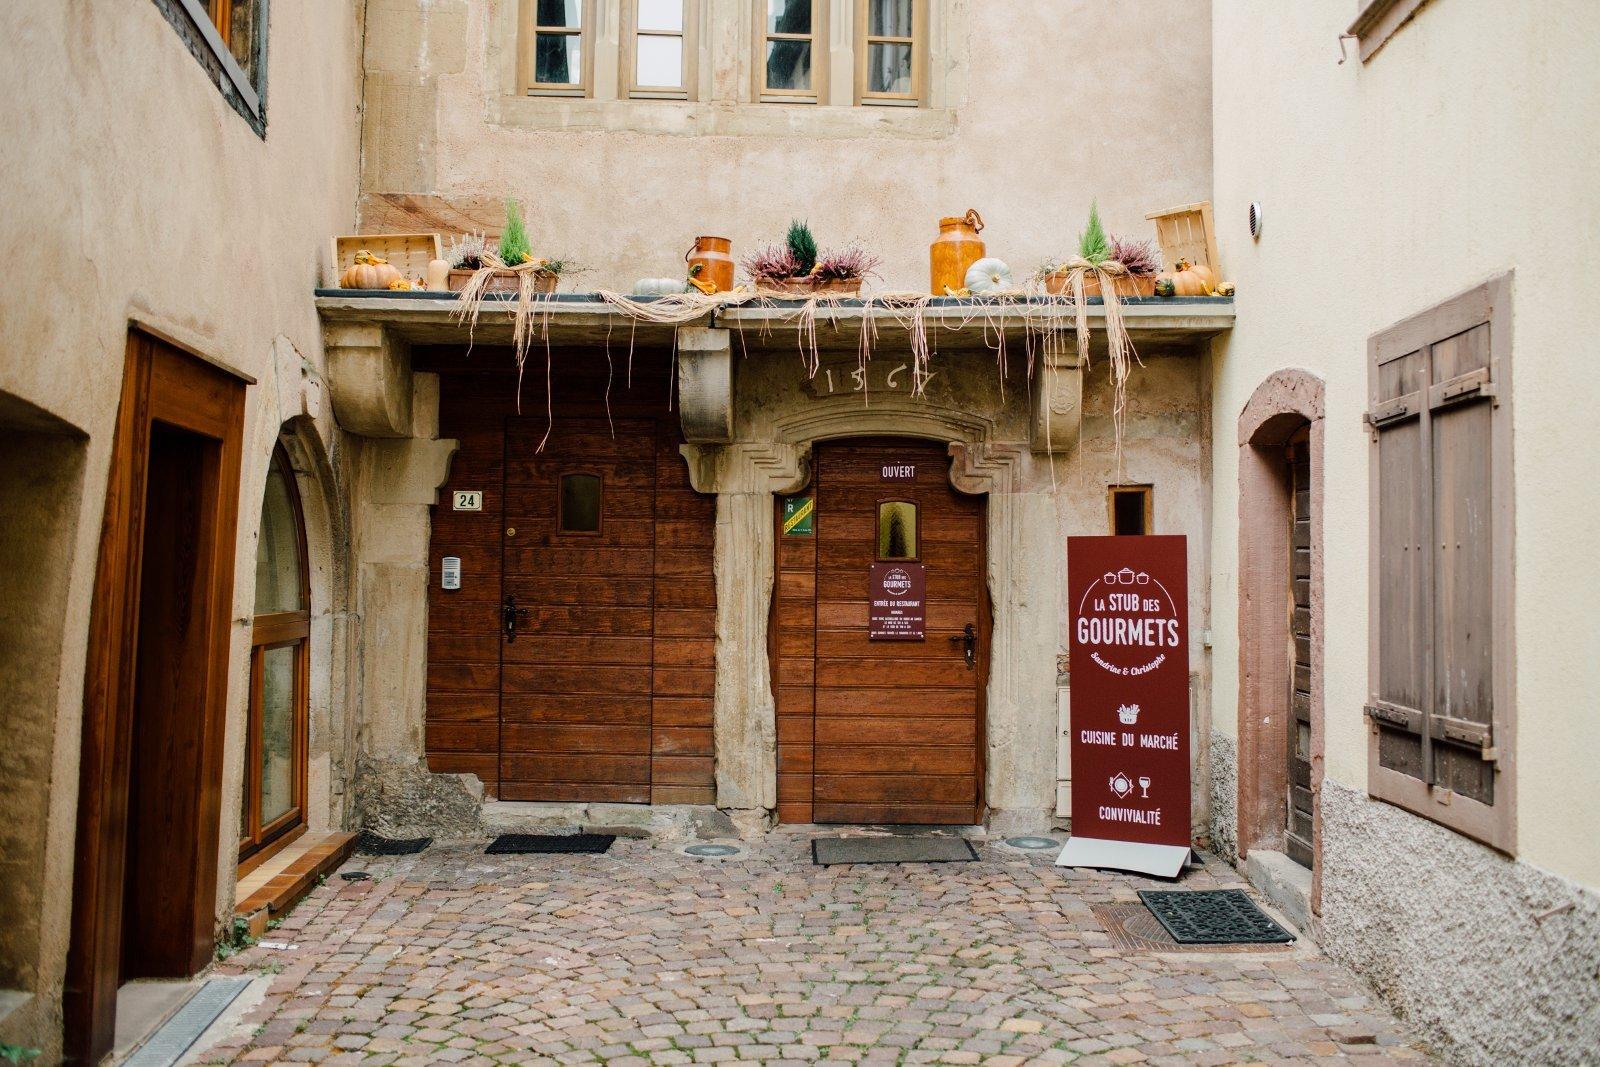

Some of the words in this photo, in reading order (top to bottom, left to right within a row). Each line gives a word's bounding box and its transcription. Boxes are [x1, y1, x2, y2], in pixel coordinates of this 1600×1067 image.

[882, 466, 916, 478] OUVERT
[460, 494, 474, 506] 24
[1094, 598, 1106, 611] LA
[1109, 594, 1140, 611] STUB
[1142, 599, 1160, 612] DES
[1077, 617, 1179, 647] GOURMETS
[1090, 652, 1121, 675] Sandrine
[1122, 667, 1129, 675] &
[1130, 653, 1166, 676] Christophe
[1081, 730, 1116, 746] CUISINE
[1122, 733, 1134, 746] DU
[1140, 732, 1179, 750] MARCHÉ
[1099, 806, 1161, 826] CONVIVIALITÉ
